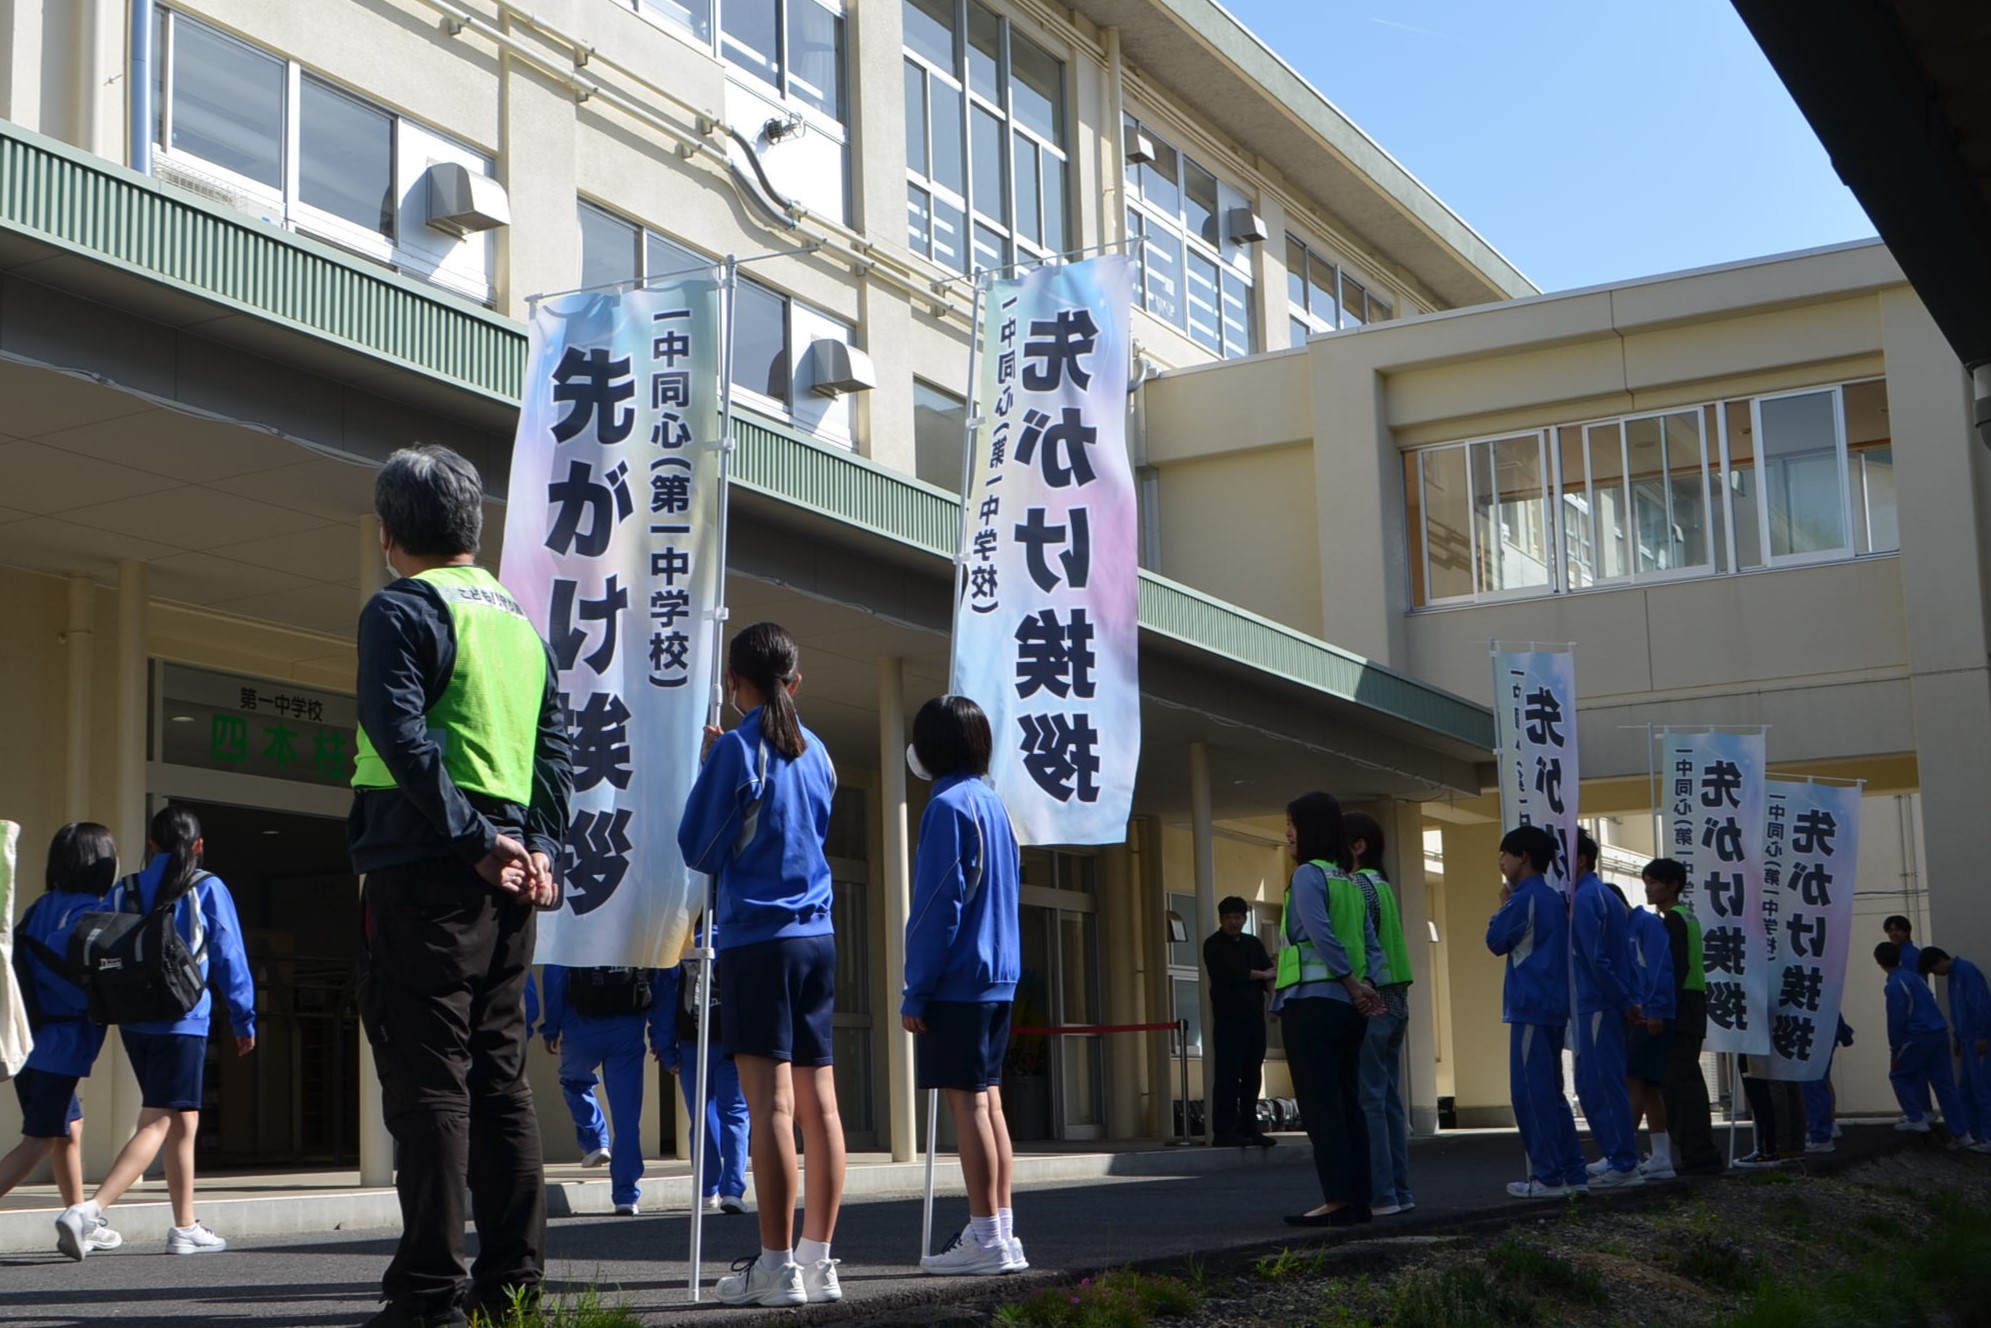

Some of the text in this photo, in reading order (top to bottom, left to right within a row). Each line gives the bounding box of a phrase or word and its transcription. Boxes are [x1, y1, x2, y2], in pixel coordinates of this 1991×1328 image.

[649, 309, 691, 688] 一中同心（第一中学校）
[240, 687, 323, 722] 第一中学校
[545, 346, 636, 916] 先がけ挨拶
[212, 713, 348, 779] 四本柱
